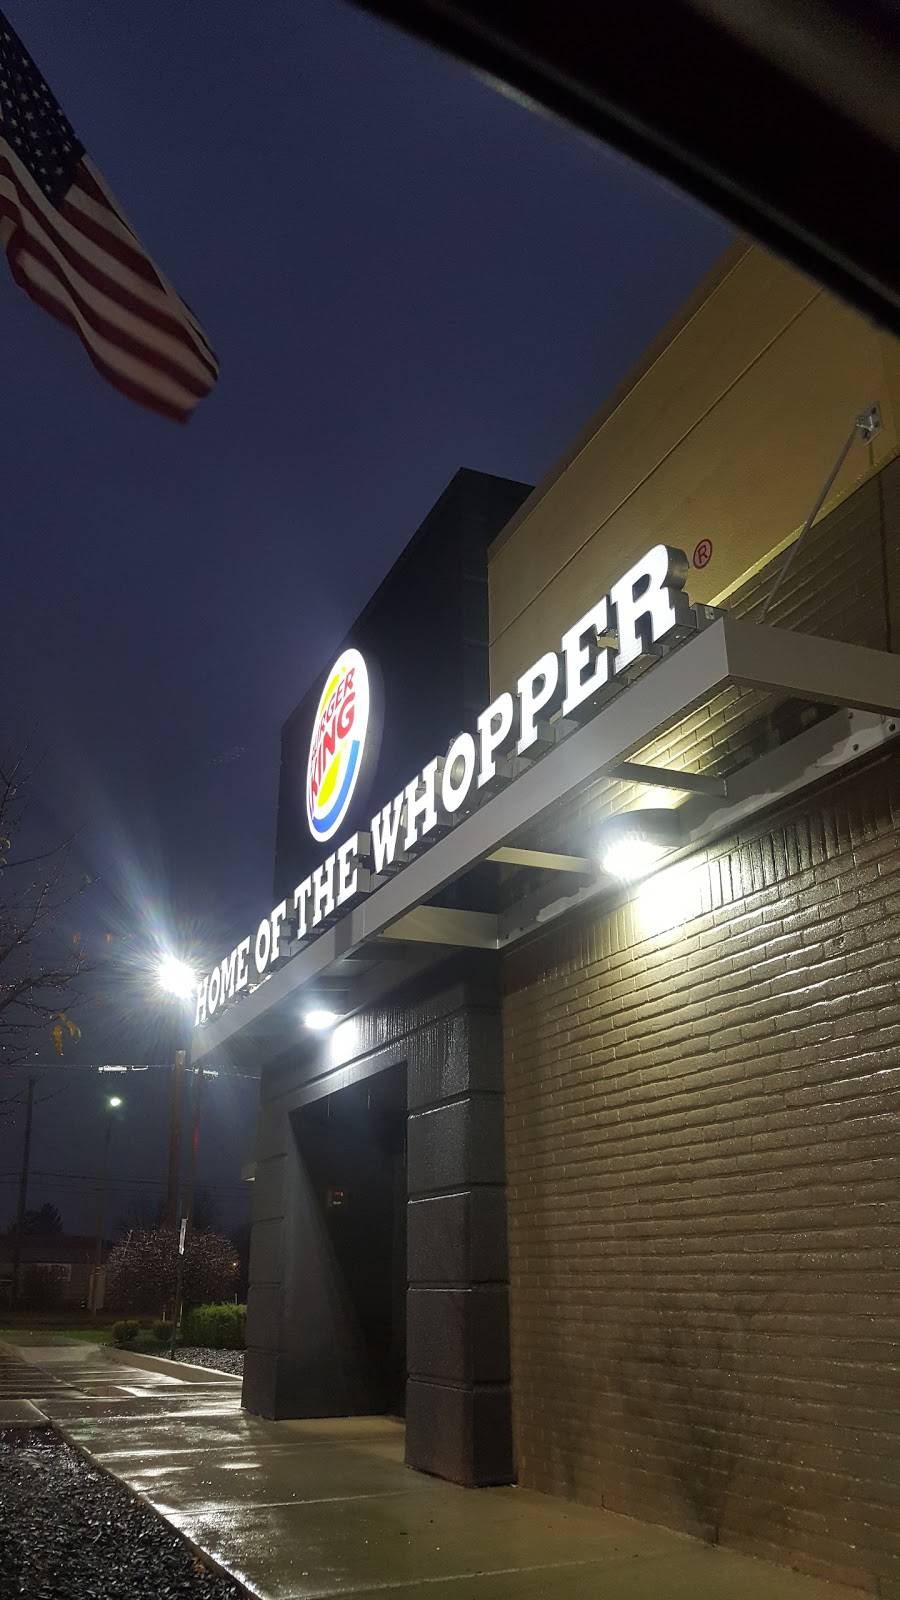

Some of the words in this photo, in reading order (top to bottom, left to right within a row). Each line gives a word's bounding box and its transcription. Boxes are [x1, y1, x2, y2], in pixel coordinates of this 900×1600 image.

[194, 935, 251, 1026] HOME
[255, 899, 286, 973] OF
[294, 832, 358, 940] THE
[371, 544, 677, 876] WHOPPER
[310, 691, 356, 798] KING
